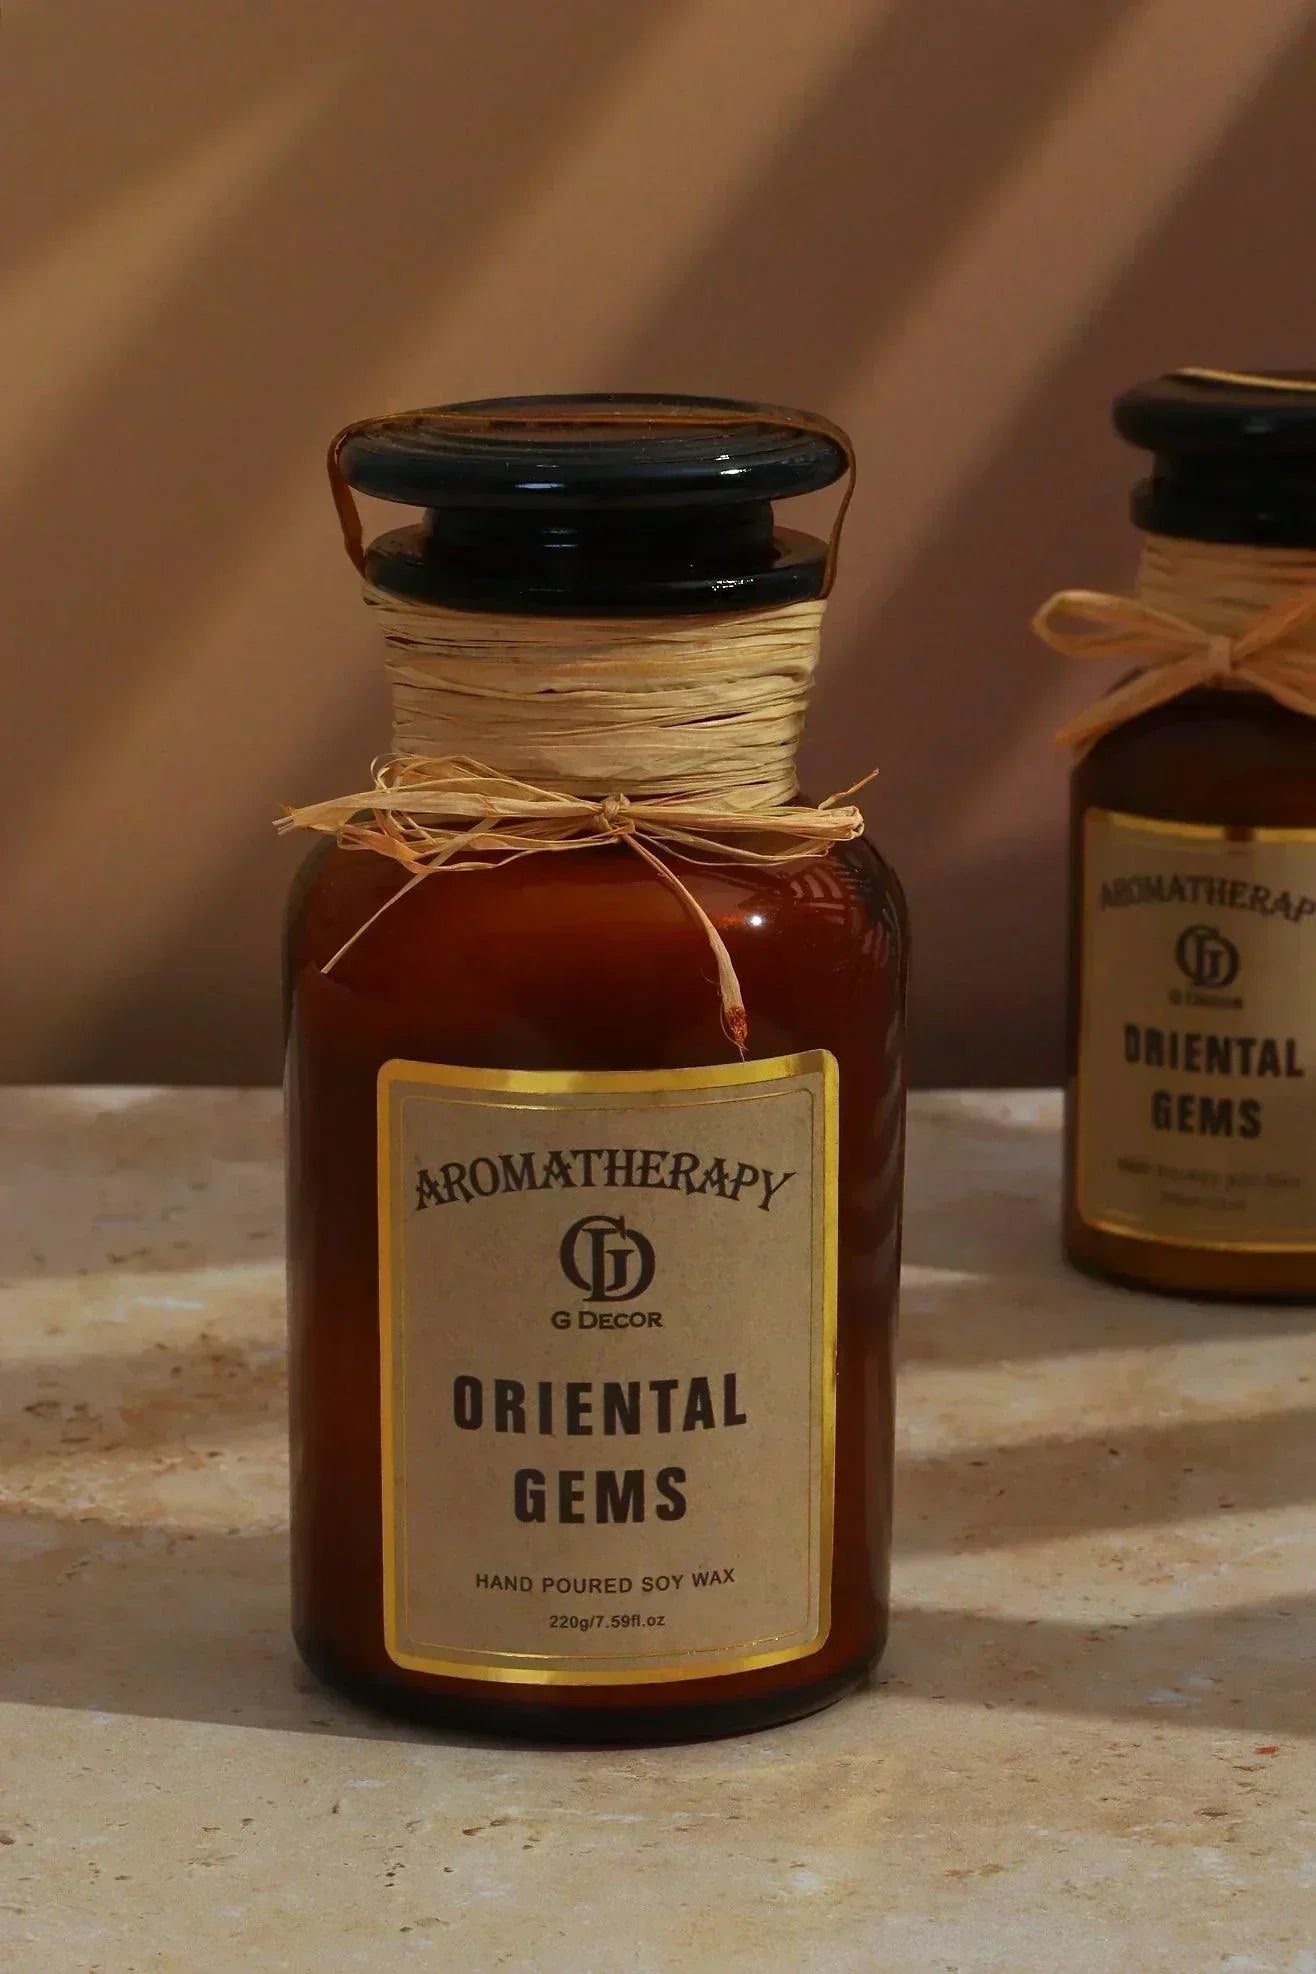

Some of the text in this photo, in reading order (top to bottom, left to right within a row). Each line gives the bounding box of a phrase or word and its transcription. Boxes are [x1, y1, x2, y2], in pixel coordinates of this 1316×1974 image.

[1124, 1023, 1305, 1078] ORIENTAL
[1151, 1089, 1262, 1139] GEMS
[415, 1149, 796, 1211] AROMATHERAPY
[551, 1311, 664, 1330] G DECOR
[453, 1372, 747, 1436] ORIENTAL
[514, 1466, 688, 1524] GEMS
[476, 1568, 736, 1594] HAND POURED SOY WAX
[549, 1614, 666, 1632] 220g/7.59fl.oz
